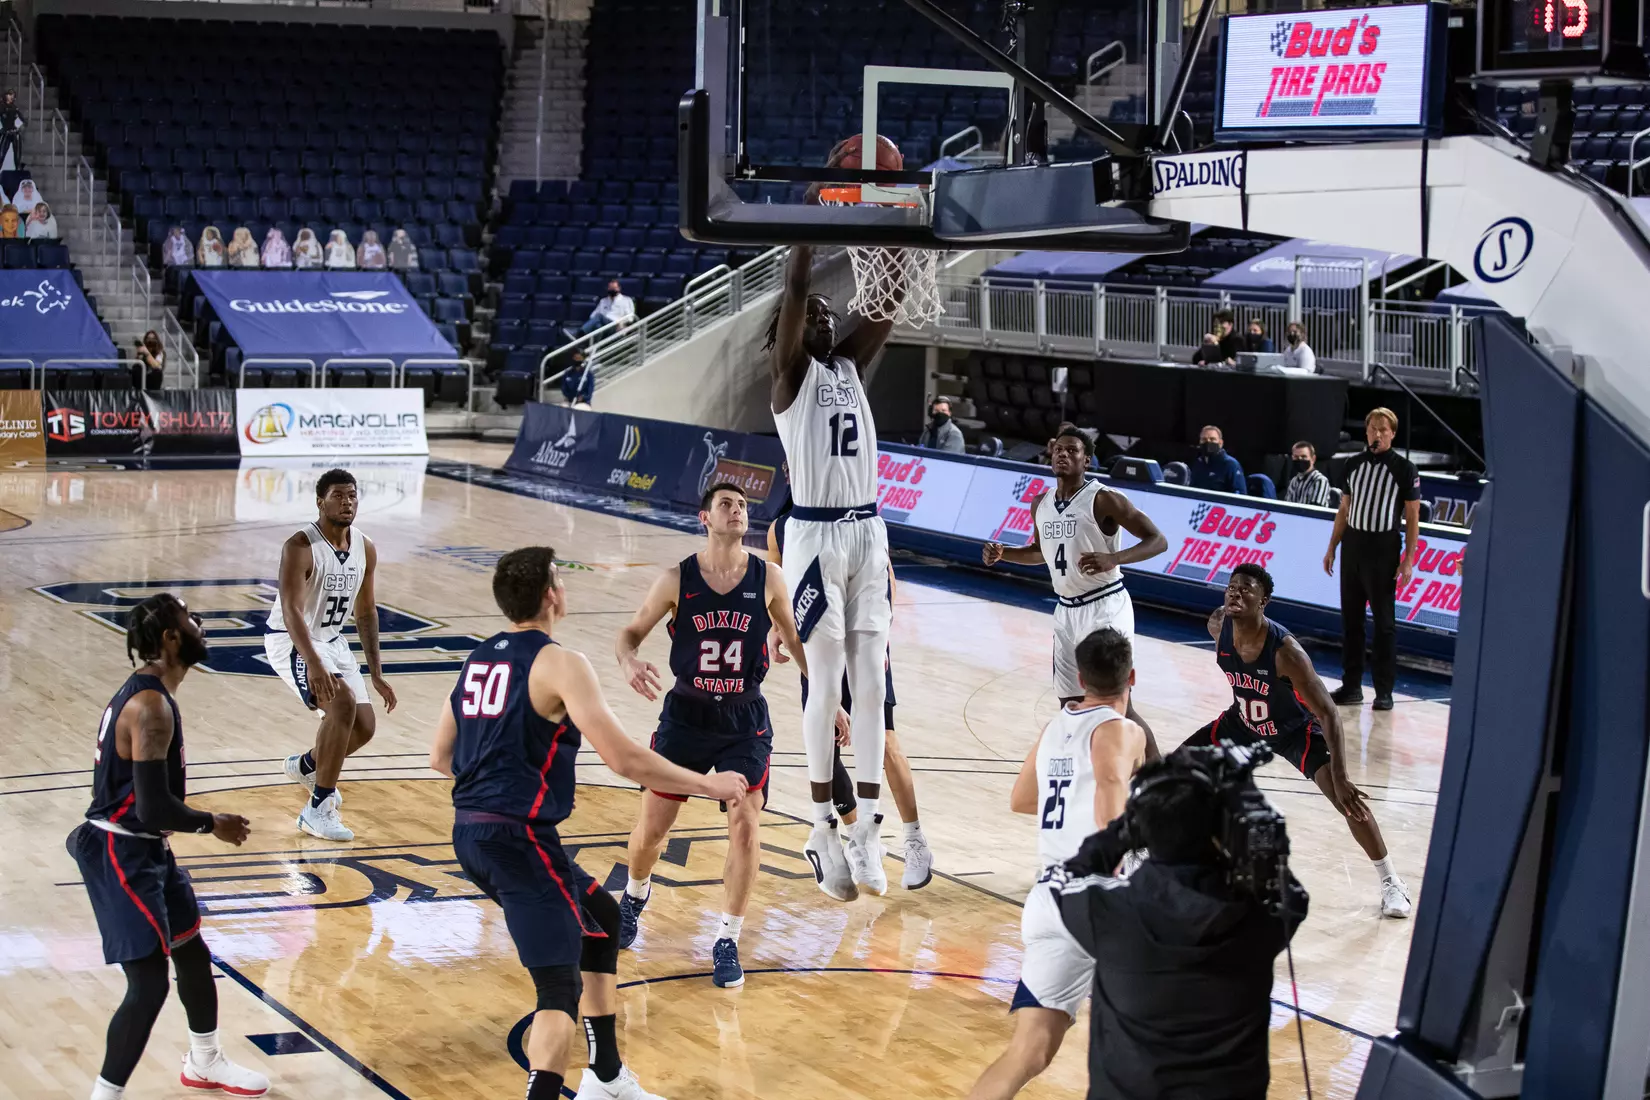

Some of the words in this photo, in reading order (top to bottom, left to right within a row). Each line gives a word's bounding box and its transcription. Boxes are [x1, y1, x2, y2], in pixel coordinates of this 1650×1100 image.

[1284, 14, 1381, 58] Bud's
[1261, 65, 1320, 117] TIRE
[1311, 63, 1387, 117] PROS
[1153, 153, 1242, 194] SPALDING
[229, 299, 405, 314] GuideStone
[300, 414, 419, 428] MAGNOLIA
[829, 413, 858, 456] 12
[530, 440, 570, 468] Altura
[1043, 520, 1076, 539] CBU
[1198, 506, 1276, 544] Bud's
[1055, 543, 1067, 576] 4
[1167, 537, 1222, 574] TIRE
[323, 574, 356, 591] CBU
[321, 596, 349, 628] 35
[692, 610, 752, 632] DIXIE
[795, 583, 819, 631] LANCERS
[700, 639, 743, 673] 24
[461, 661, 512, 718] 50
[694, 677, 744, 693] STATE
[1226, 671, 1270, 696] DIXIE
[1041, 779, 1072, 829] 25
